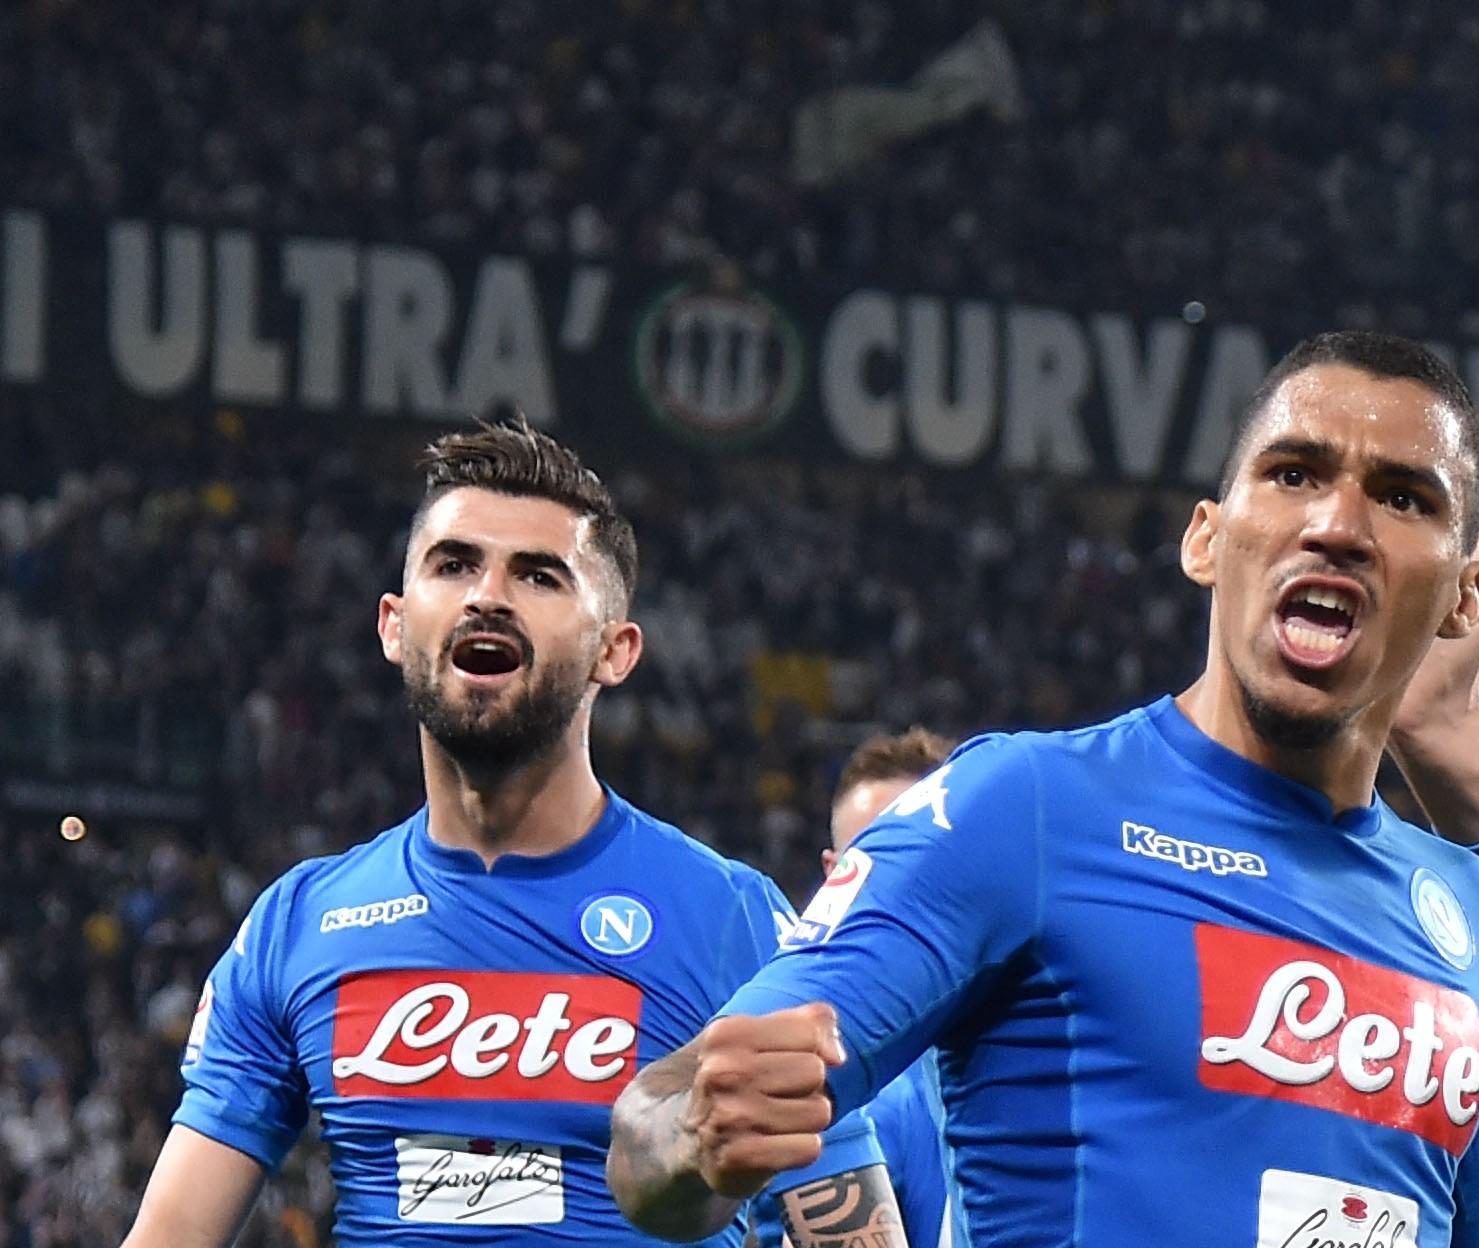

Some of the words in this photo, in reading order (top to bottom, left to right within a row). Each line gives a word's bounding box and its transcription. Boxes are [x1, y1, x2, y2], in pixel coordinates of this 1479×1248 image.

[1122, 821, 1267, 877] Kappa
[320, 895, 428, 932] Kappa
[597, 907, 636, 945] N
[333, 982, 636, 1085] Lete
